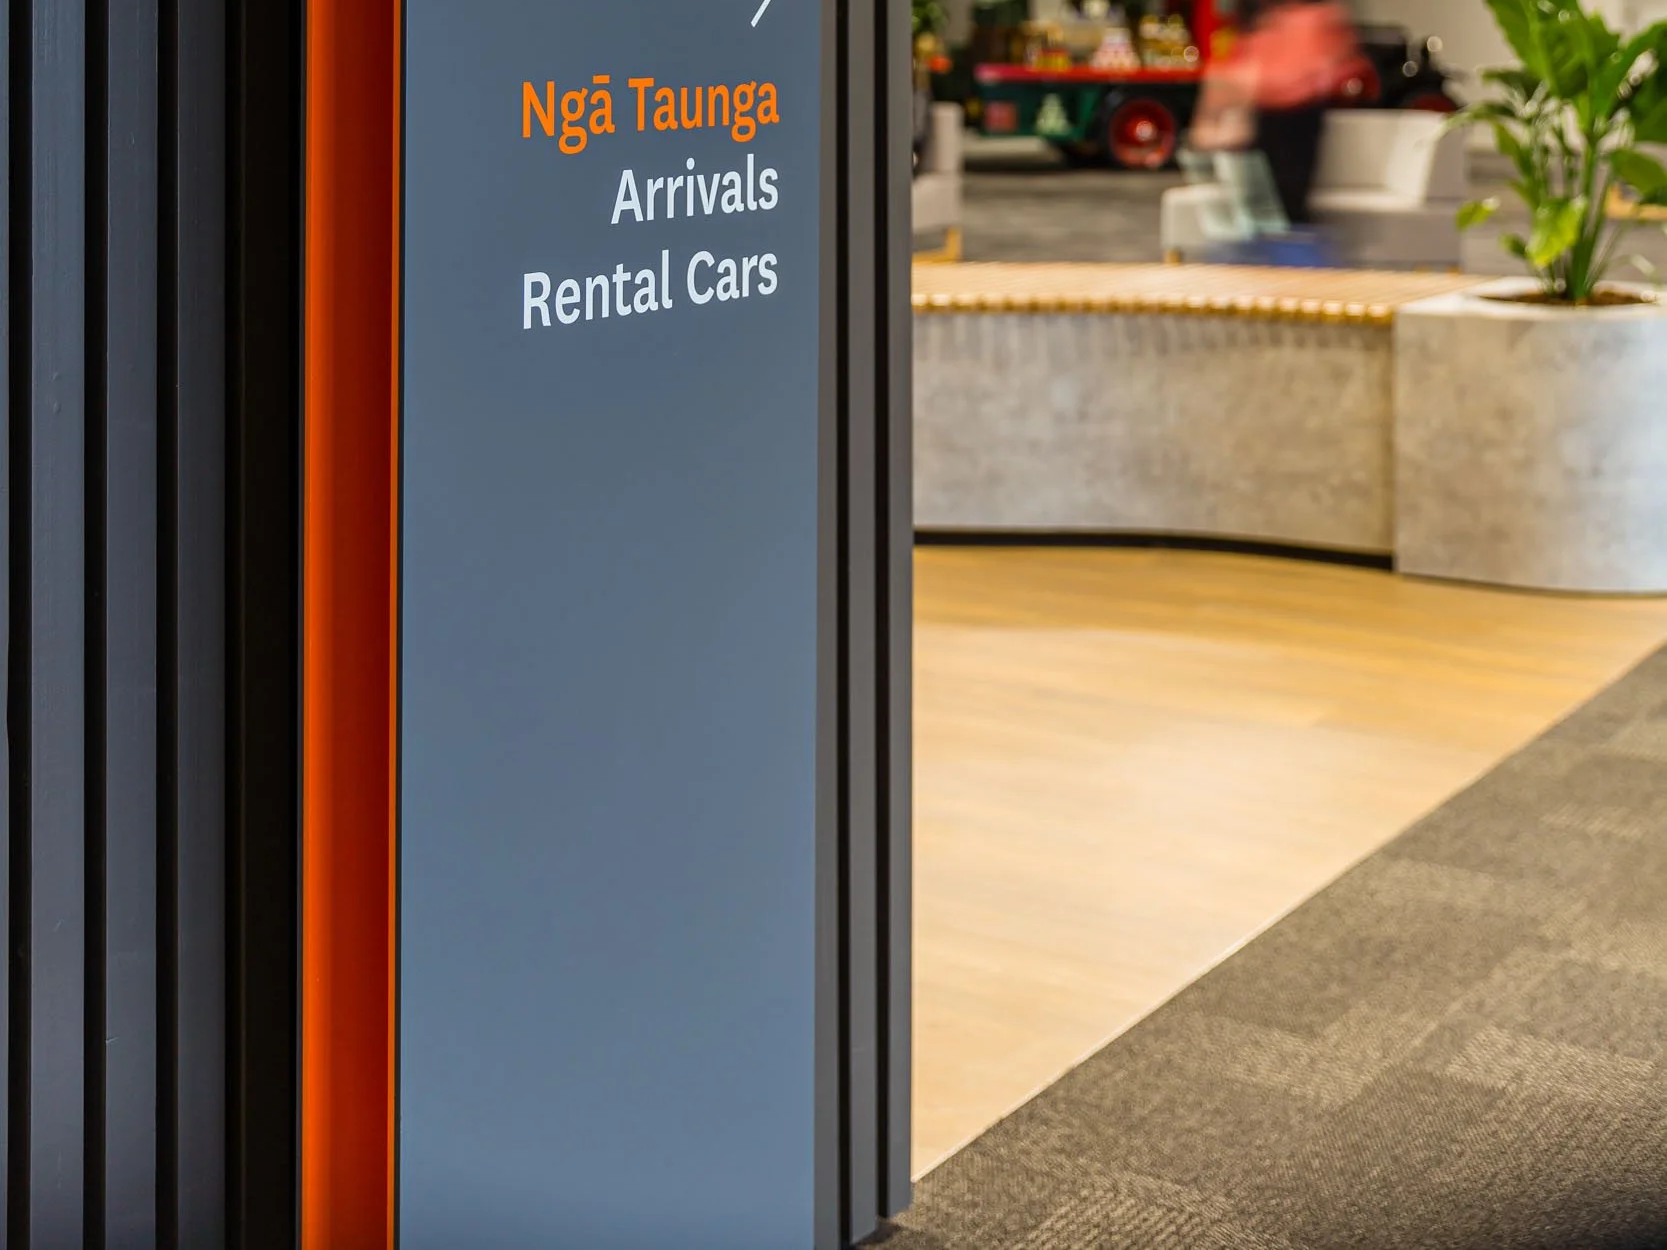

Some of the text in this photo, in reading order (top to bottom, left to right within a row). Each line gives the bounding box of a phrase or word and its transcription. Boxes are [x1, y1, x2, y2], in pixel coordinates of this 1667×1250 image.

[522, 74, 780, 155] Ngā Taunga
[610, 153, 779, 225] Arrivals
[523, 249, 778, 330] Rental Cars
